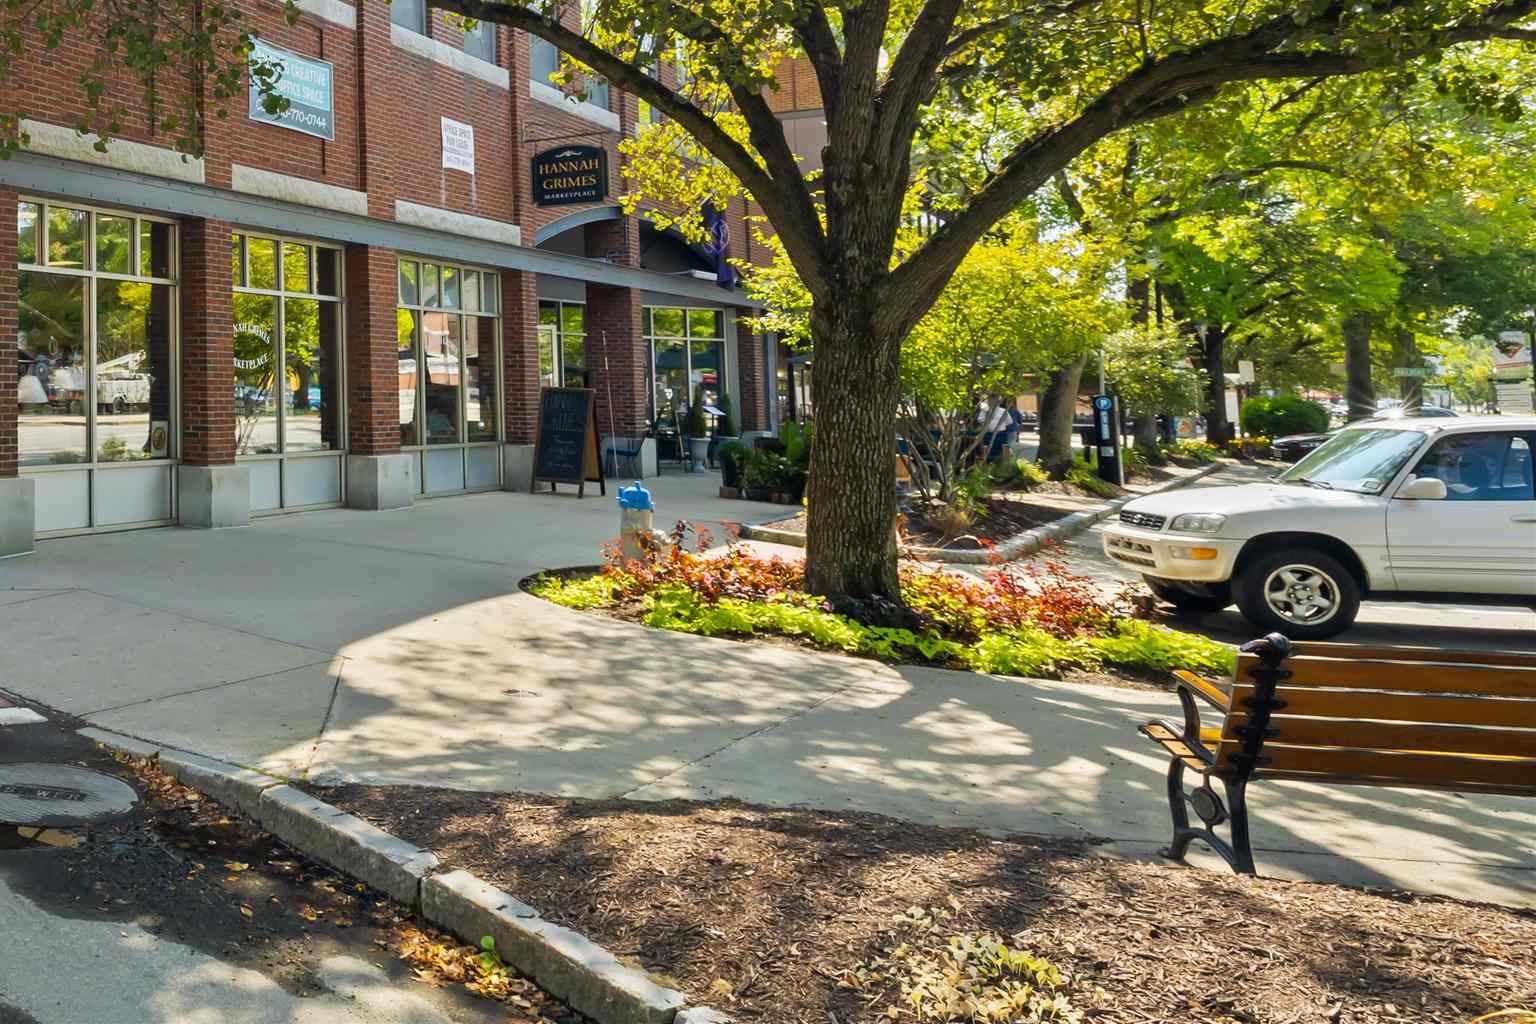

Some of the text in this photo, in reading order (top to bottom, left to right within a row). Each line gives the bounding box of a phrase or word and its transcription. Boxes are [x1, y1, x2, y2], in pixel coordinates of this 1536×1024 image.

[539, 159, 599, 175] HANNAH
[543, 175, 597, 190] GRIMES
[544, 190, 596, 200] MARKETPLACE
[233, 352, 269, 370] RKETPLACE
